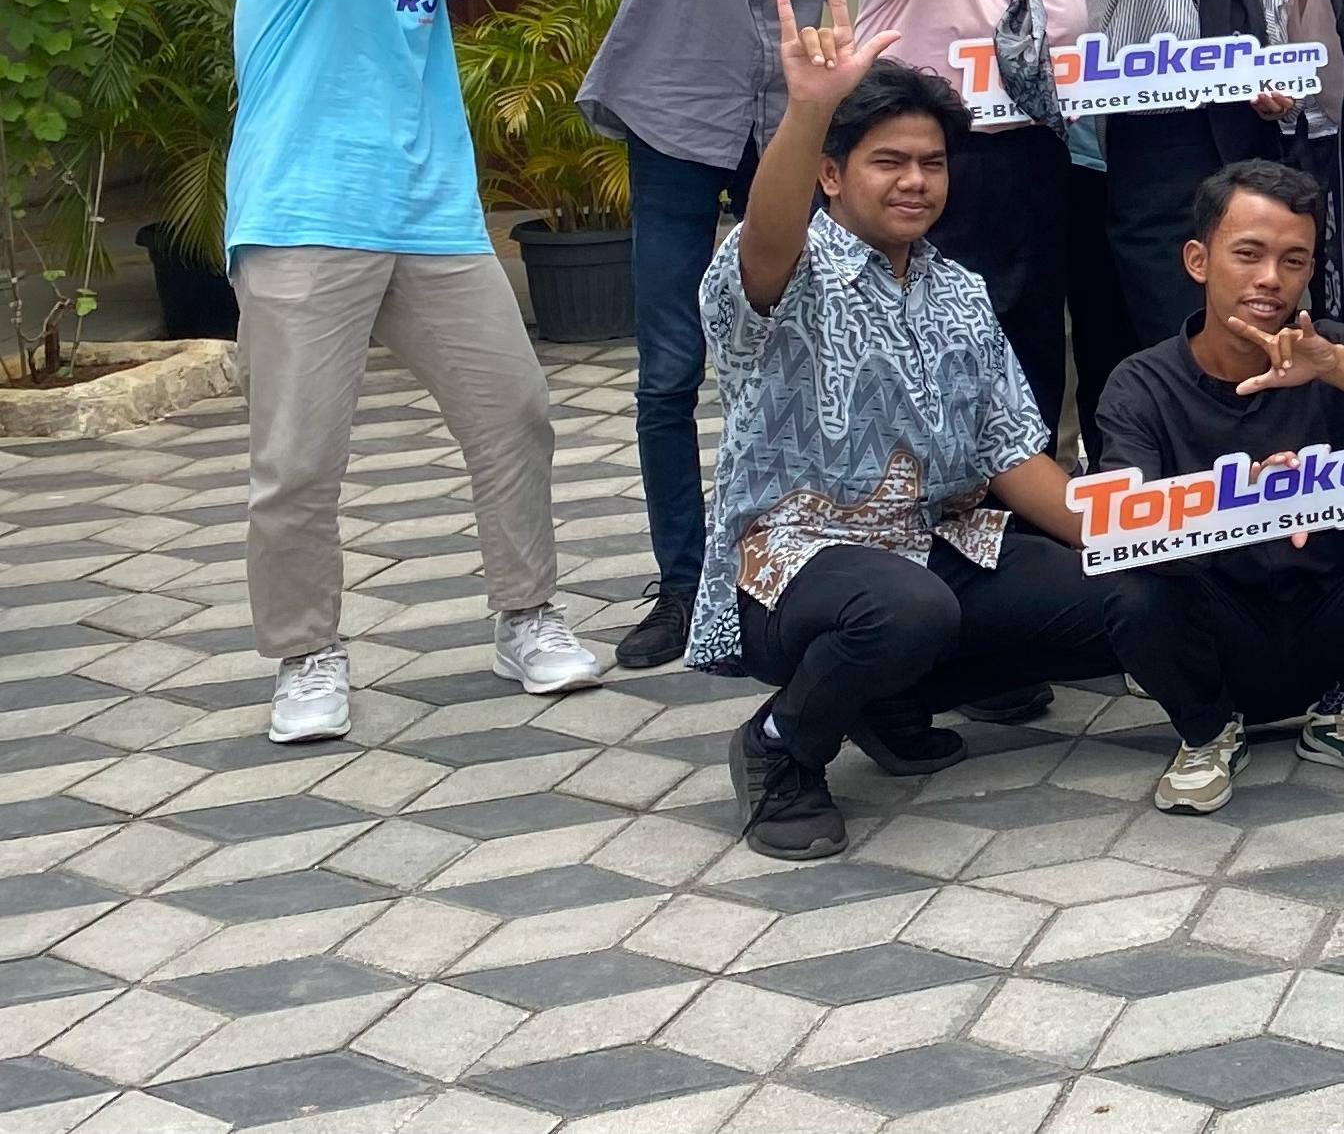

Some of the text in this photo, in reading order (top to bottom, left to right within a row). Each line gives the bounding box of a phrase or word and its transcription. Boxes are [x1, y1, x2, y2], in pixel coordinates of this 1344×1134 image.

[959, 40, 1320, 93] TpLoker.com
[1137, 83, 1253, 105] Study+Tes
[1259, 77, 1317, 93] Kerja
[1086, 518, 1271, 567] E-BKK+Tracer
